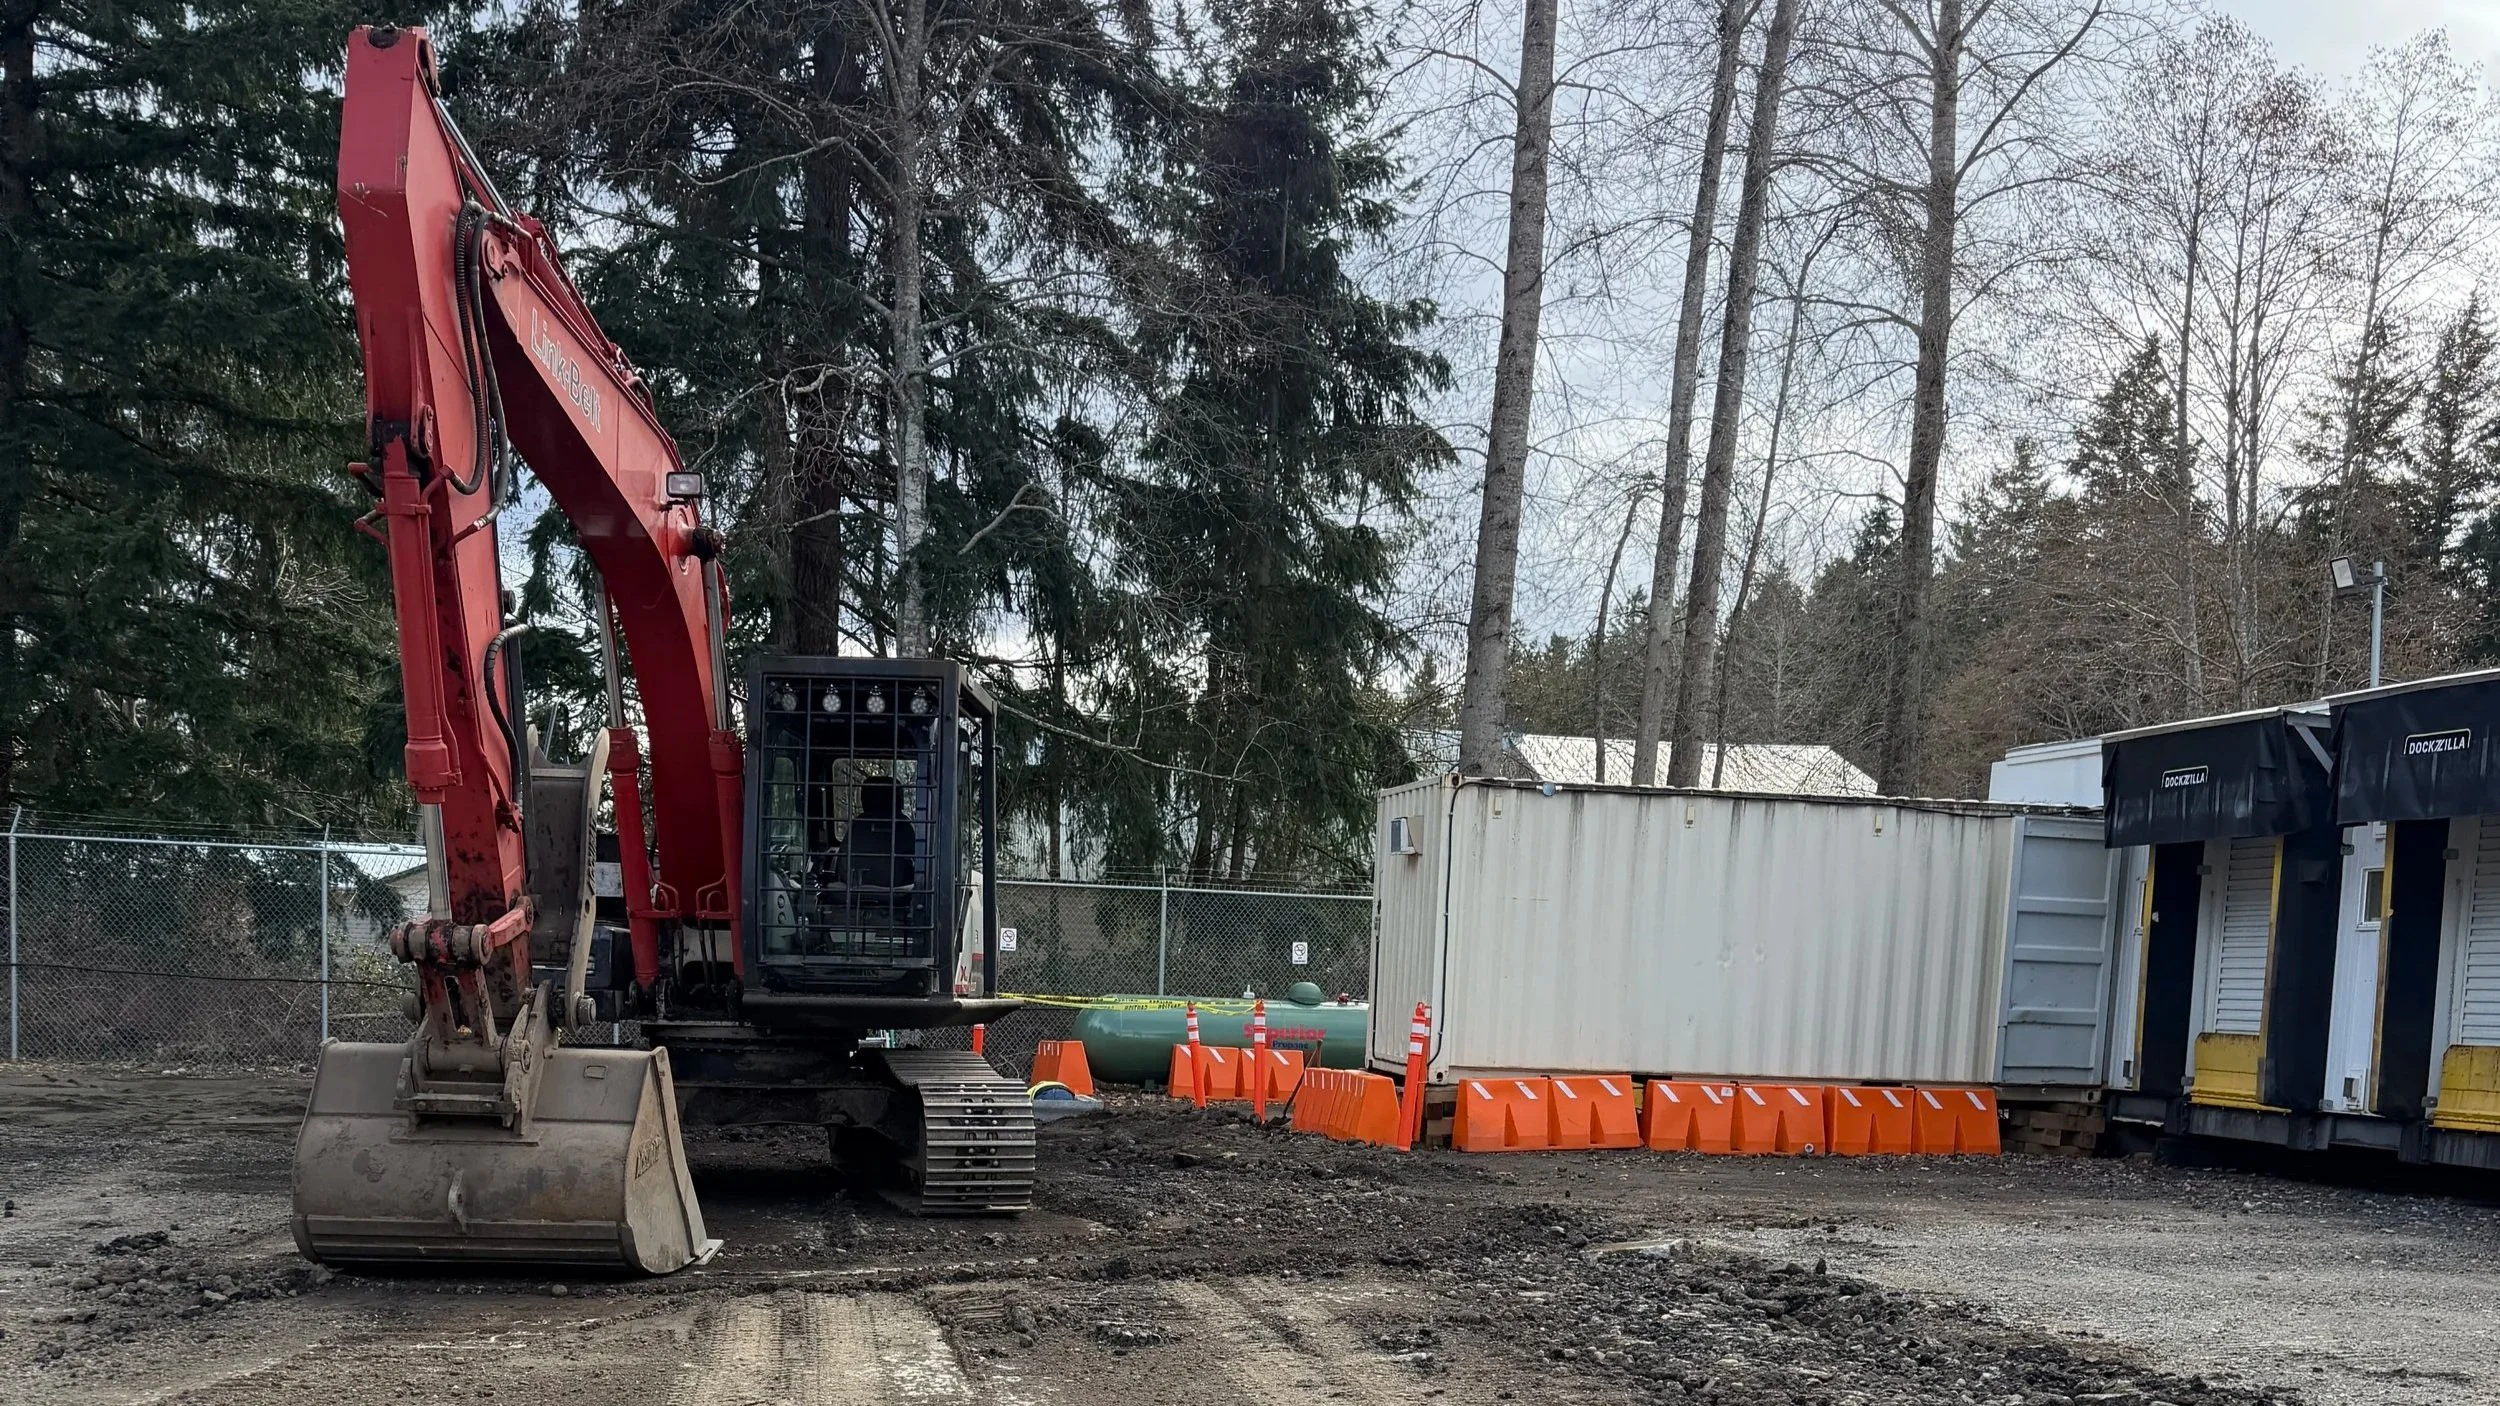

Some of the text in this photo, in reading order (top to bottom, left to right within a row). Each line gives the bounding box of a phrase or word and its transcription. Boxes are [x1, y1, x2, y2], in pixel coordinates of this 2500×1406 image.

[531, 306, 601, 434] Link-Belt
[2408, 736, 2466, 755] DOCKZILLA
[2164, 772, 2205, 788] DOCKZILLA
[1244, 1023, 1326, 1048] Sperior
